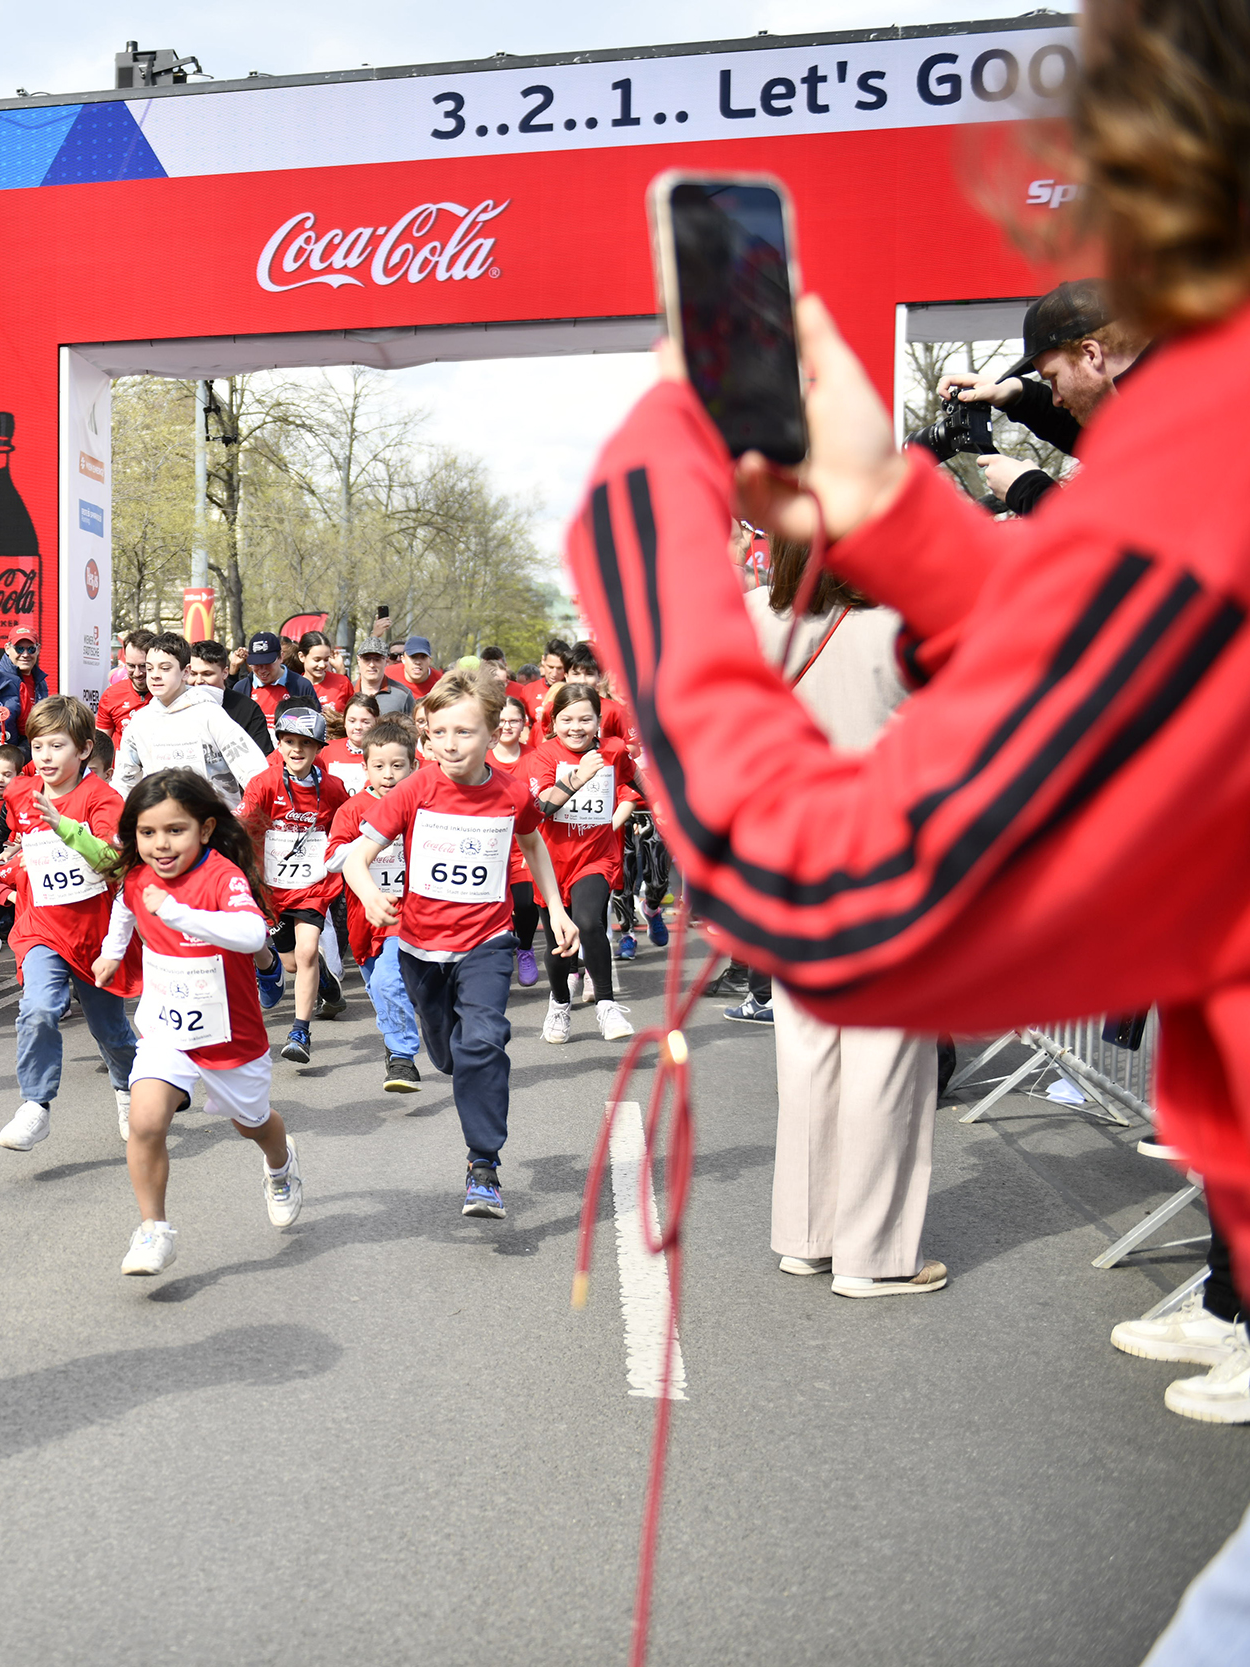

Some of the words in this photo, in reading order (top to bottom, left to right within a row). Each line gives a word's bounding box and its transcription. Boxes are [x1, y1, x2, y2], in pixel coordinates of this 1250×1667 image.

[719, 60, 887, 119] Let's
[256, 198, 511, 292] Coca-Cola
[285, 809, 319, 823] Coca-Cola
[569, 798, 604, 814] 143
[423, 839, 457, 854] Coca-Cola
[43, 867, 85, 891] 495
[277, 863, 312, 878] 773
[430, 862, 488, 887] 659
[158, 1005, 204, 1032] 492
